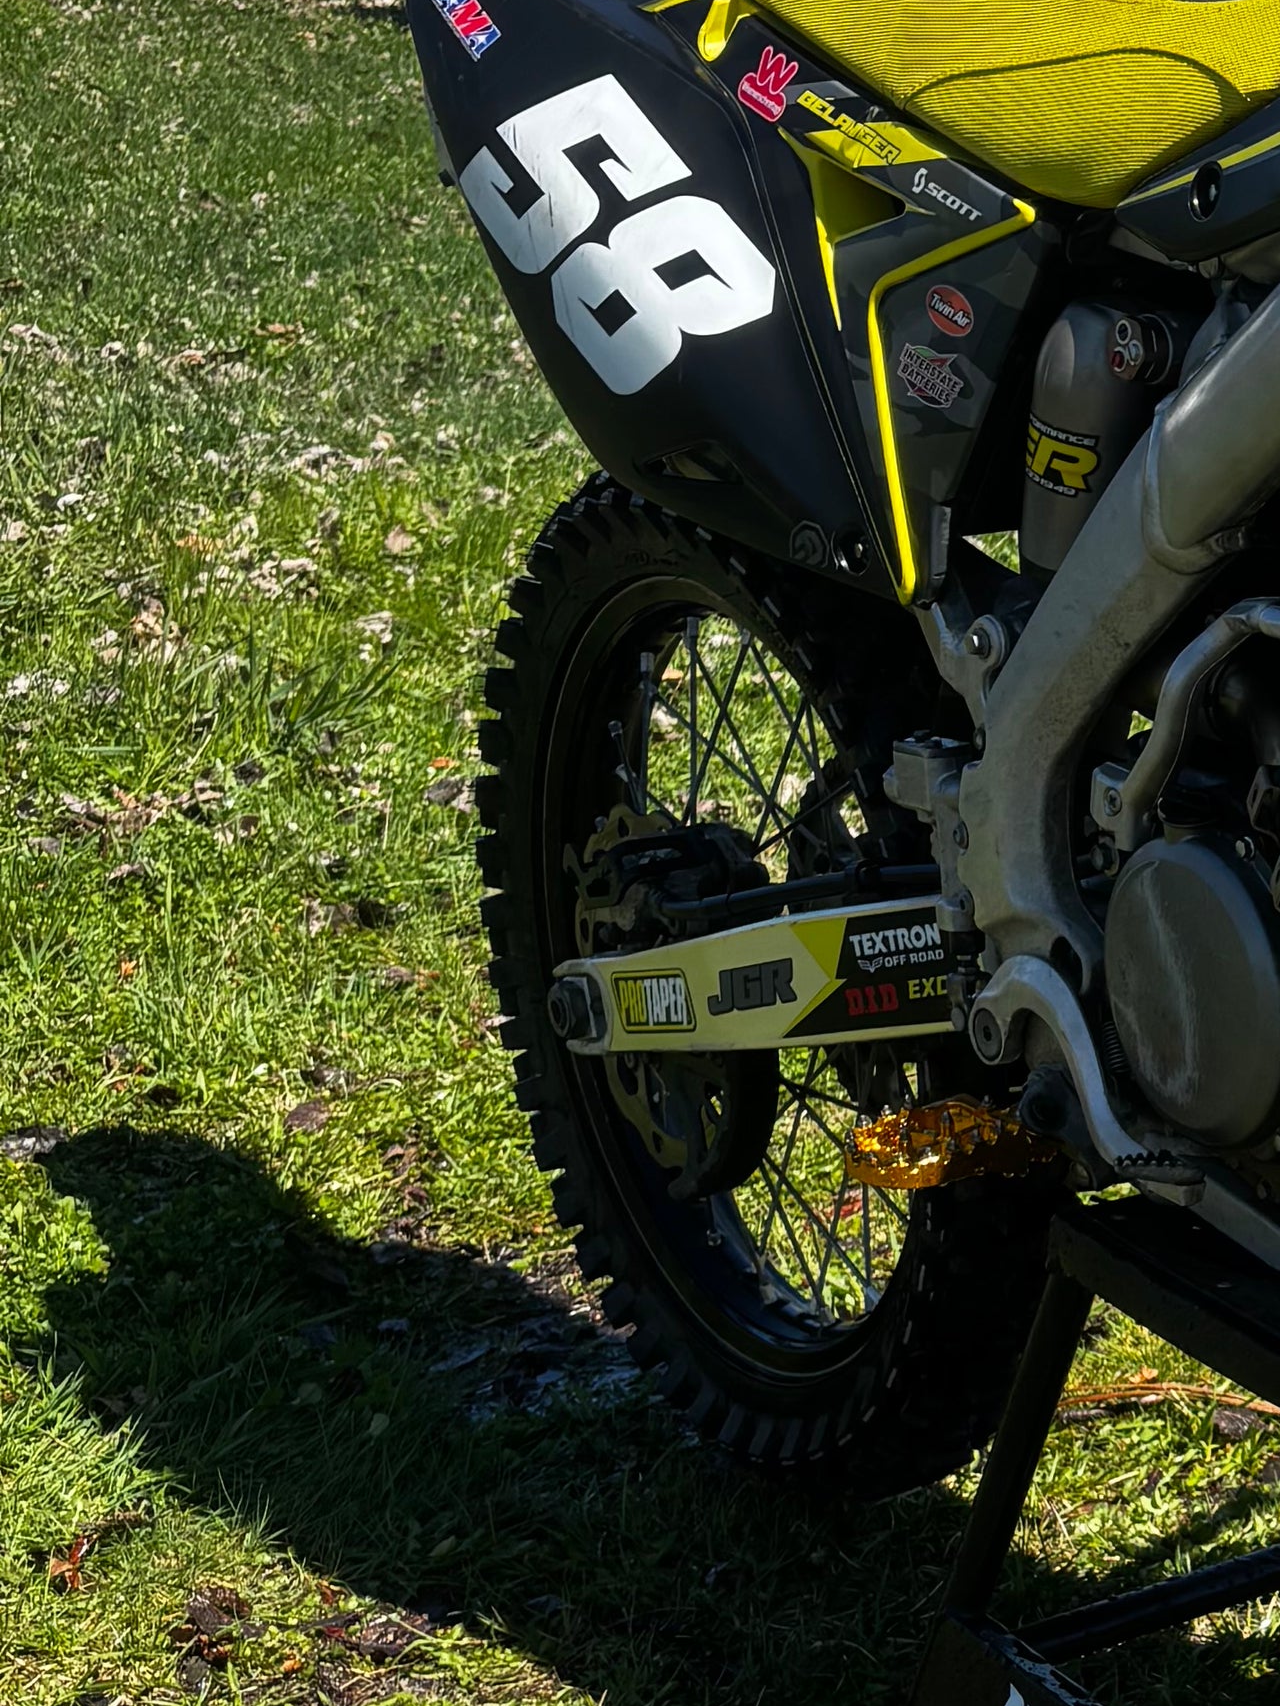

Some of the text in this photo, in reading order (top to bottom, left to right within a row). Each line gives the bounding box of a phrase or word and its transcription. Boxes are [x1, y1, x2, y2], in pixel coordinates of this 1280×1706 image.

[924, 181, 982, 221] SCOTT
[457, 73, 776, 395] 58
[900, 362, 952, 403] BATTERIES
[902, 347, 962, 391] INTERSTATE
[850, 923, 942, 957] TEXTRON
[884, 949, 944, 968] OFF ROAD
[707, 958, 797, 1016] JGR
